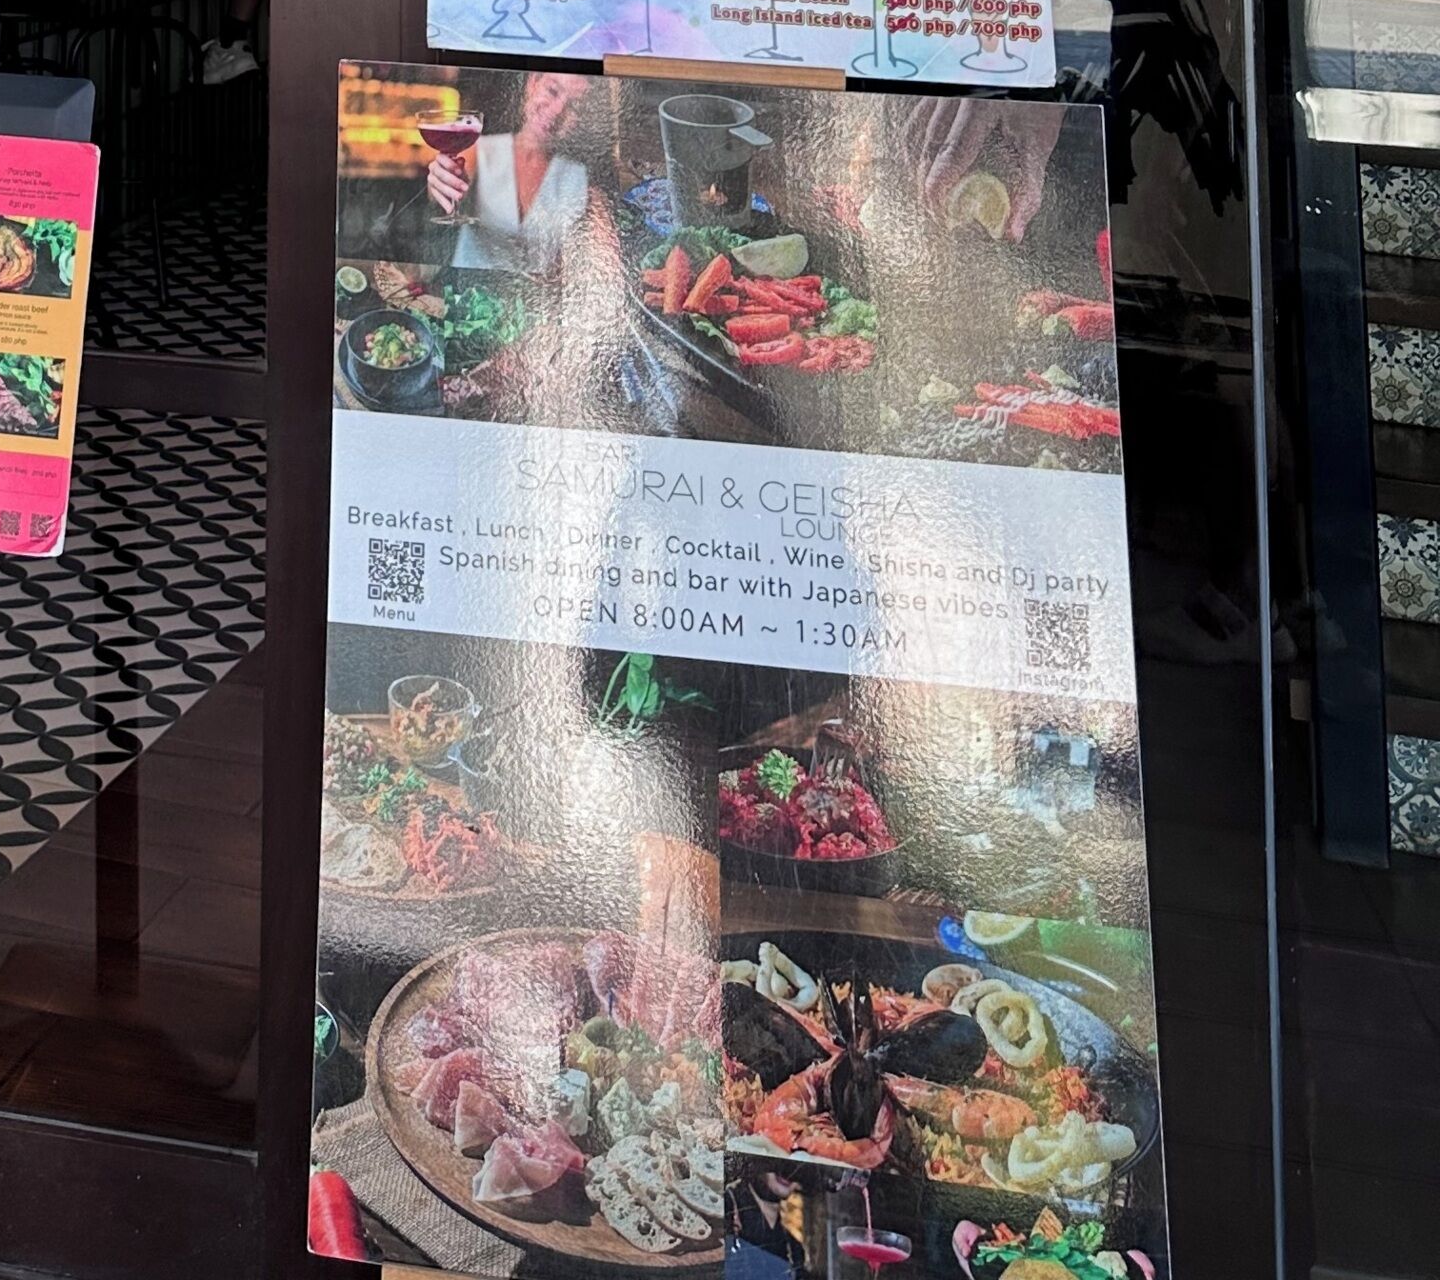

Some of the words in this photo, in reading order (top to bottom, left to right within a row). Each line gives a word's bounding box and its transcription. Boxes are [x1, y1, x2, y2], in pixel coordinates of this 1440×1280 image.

[711, 4, 753, 23] Long
[754, 7, 805, 26] Island
[844, 13, 874, 30] tea
[971, 0, 1007, 14] 600
[1010, 2, 1041, 19] php
[923, 19, 956, 36] php
[972, 22, 1007, 37] 700
[1010, 25, 1042, 41] php
[517, 459, 704, 506] SAMURAI
[720, 477, 744, 509] &
[759, 481, 920, 523] GEISHA
[348, 506, 453, 534] Breakfast
[476, 518, 544, 541] Lunch
[568, 526, 642, 552] Dinner
[665, 535, 761, 562] Cocktail
[784, 545, 845, 570] Wine
[868, 554, 946, 580] Shisha
[957, 565, 1002, 585] and
[1012, 567, 1035, 590] Dj
[1045, 574, 1109, 599] party
[439, 546, 534, 574] Spanish
[544, 559, 621, 588] dining
[632, 568, 677, 588] and
[688, 568, 728, 592] bar
[739, 577, 792, 599] with
[802, 580, 927, 611] Japanese
[938, 597, 1009, 619] vibes
[372, 605, 416, 622] Menu
[533, 595, 618, 625] OPEN
[633, 603, 744, 637] 8:00AM
[796, 619, 907, 652] 1:30AM
[1018, 669, 1105, 692] Instagram
